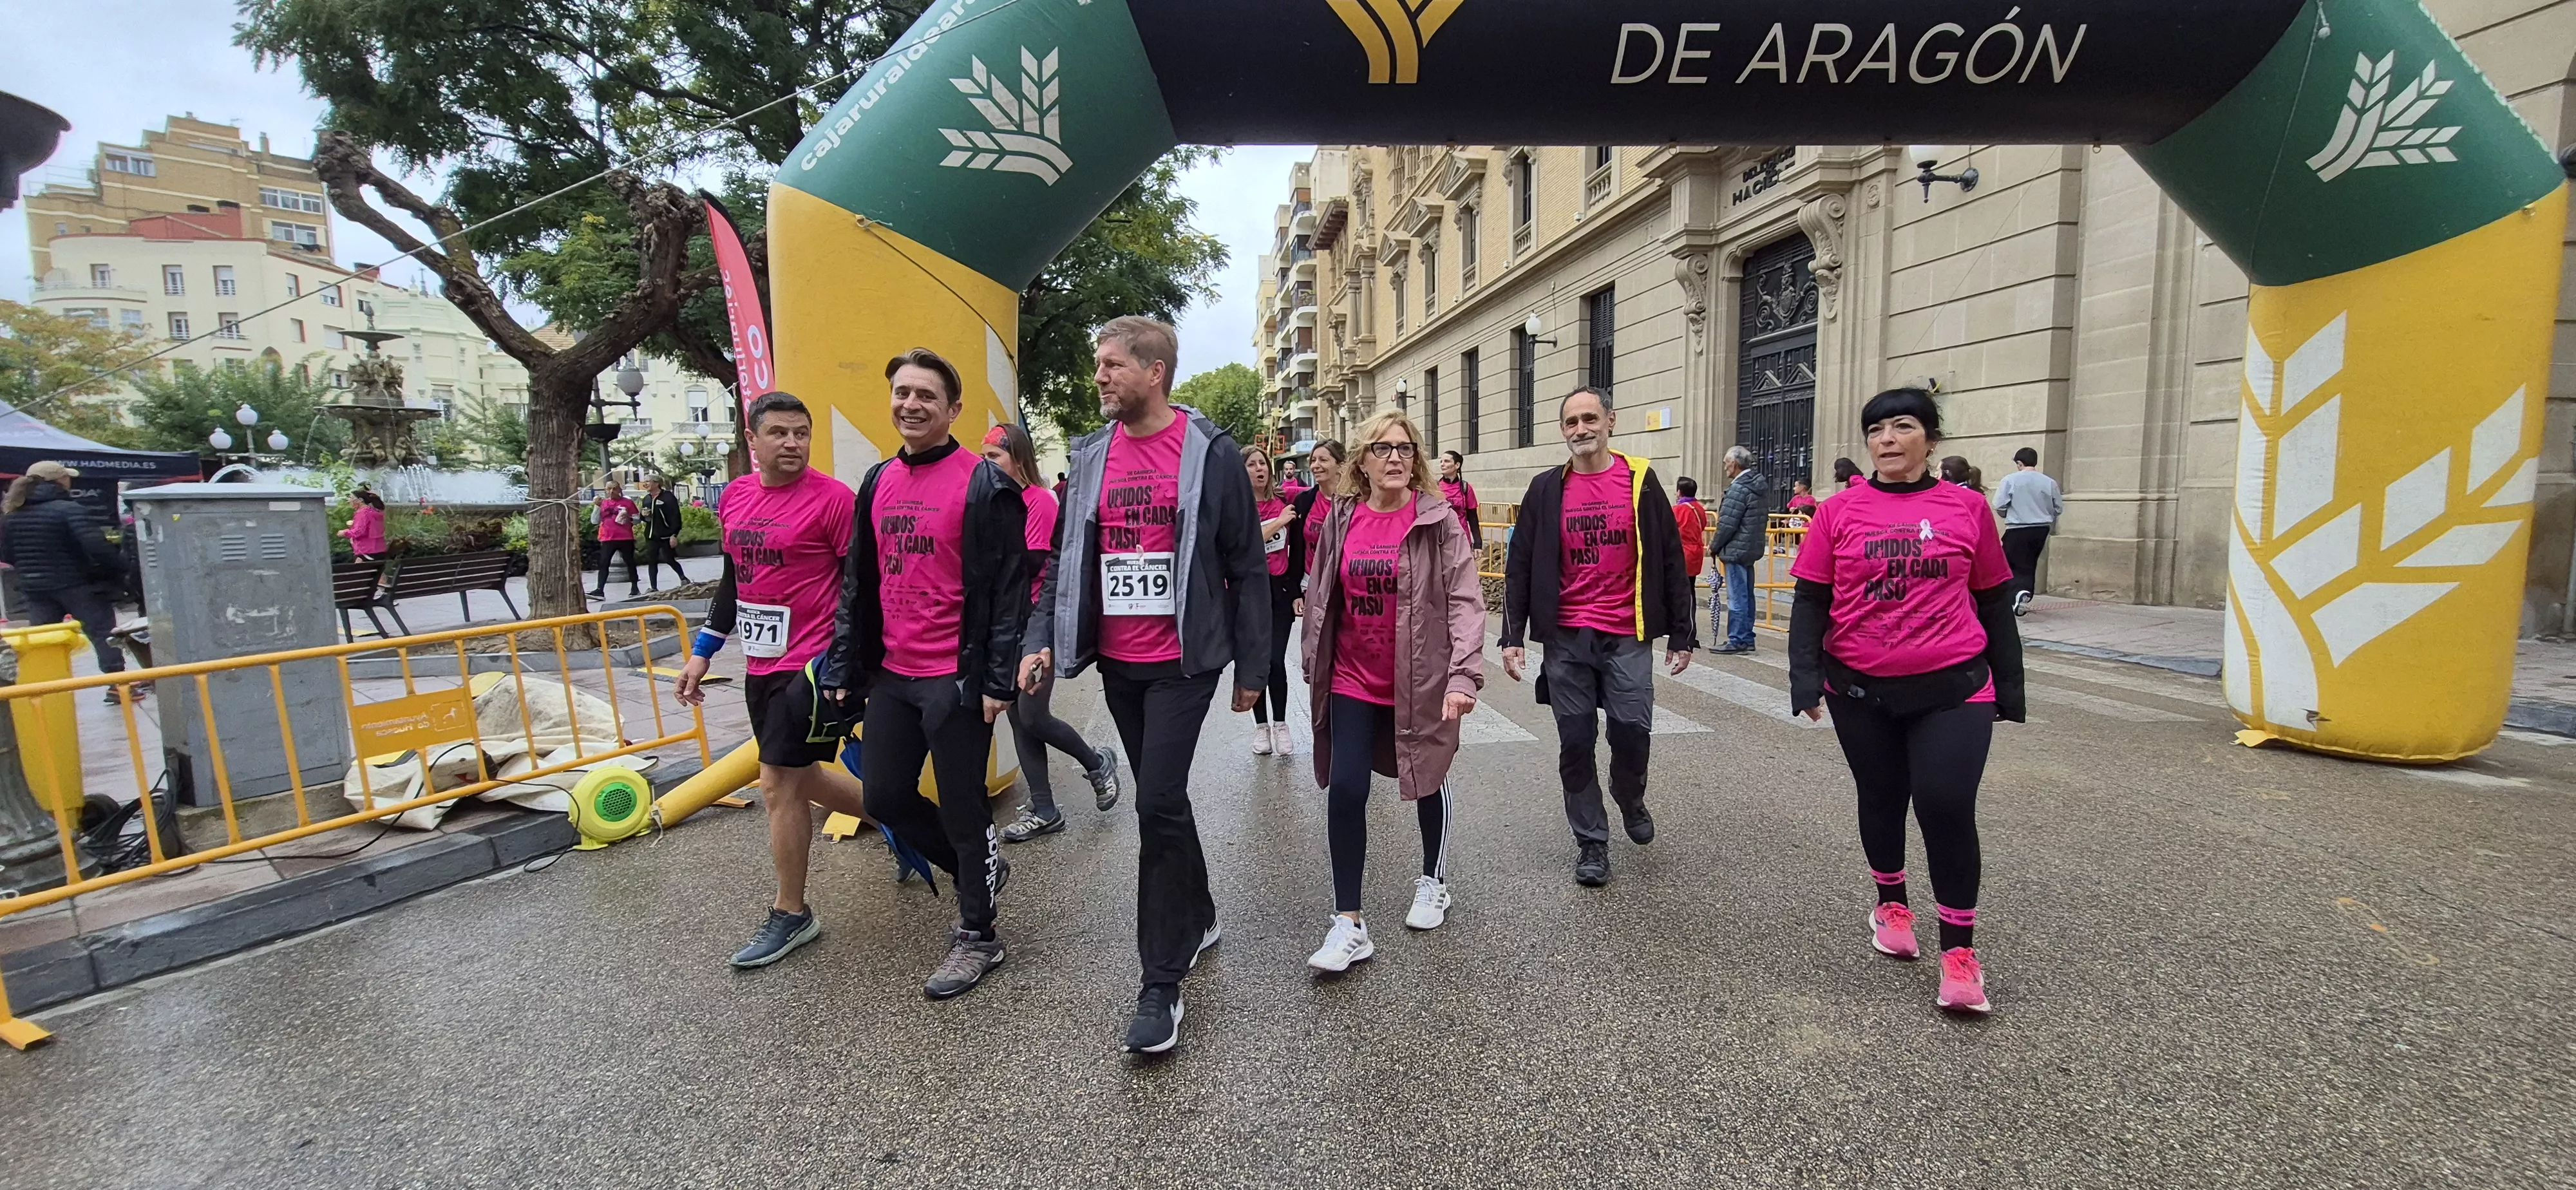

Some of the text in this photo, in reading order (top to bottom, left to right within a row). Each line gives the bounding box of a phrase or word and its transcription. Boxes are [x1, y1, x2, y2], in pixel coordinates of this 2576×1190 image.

[1611, 6, 2087, 84] DE ARAGÓN
[55, 460, 156, 469] WW.HADMEDIA.ES
[1107, 486, 1152, 509] UNIDOS
[1124, 505, 1177, 526] EN CADA
[1566, 514, 1607, 533] UNIDOS
[904, 535, 935, 555] CADA
[1109, 527, 1141, 549] PASO
[1584, 529, 1627, 547] EN CADA
[1569, 547, 1599, 565] PASO
[1864, 538, 1922, 560] UNIDOS
[1141, 563, 1167, 571] CÁNCER
[1348, 558, 1393, 577] UNIDOS
[1887, 558, 1949, 579] EN CADA
[1110, 574, 1168, 596] 2519
[1366, 577, 1397, 595] EN CA
[1863, 579, 1907, 601] PASO
[1351, 596, 1384, 616] PASO
[739, 619, 777, 643] 1971
